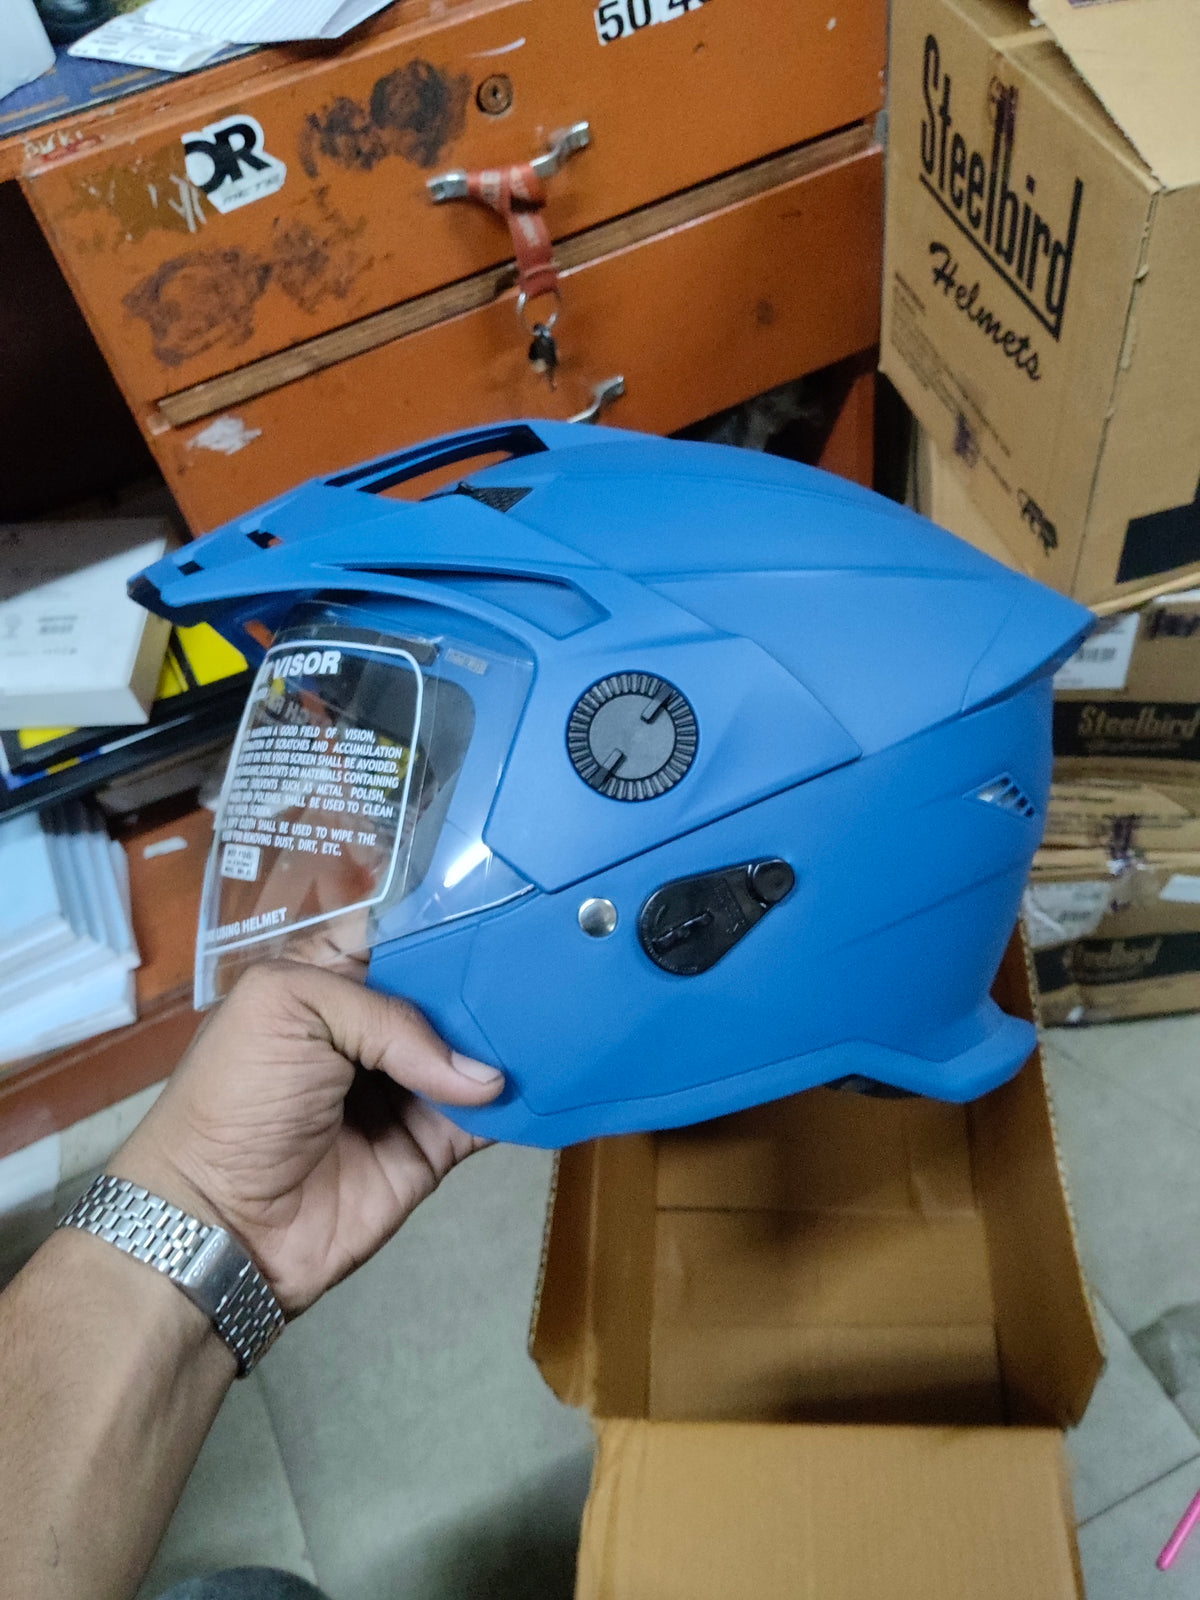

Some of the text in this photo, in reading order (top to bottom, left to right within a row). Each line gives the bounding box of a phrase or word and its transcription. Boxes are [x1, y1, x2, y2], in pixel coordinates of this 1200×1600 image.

[921, 33, 1083, 318] Steelbird
[929, 242, 1041, 381] Helmets
[273, 650, 342, 679] VISOR
[280, 725, 299, 737] GOOD
[300, 725, 320, 738] FIELD
[325, 727, 338, 739] OF
[345, 728, 376, 743] VISION,
[1077, 703, 1200, 740] Steelbird
[273, 752, 290, 764] VISOR
[290, 752, 317, 766] SCREEN
[317, 754, 342, 768] SHALL
[344, 757, 356, 769] BE
[275, 739, 311, 752] SCRATCHES
[311, 740, 329, 753] AND
[332, 741, 403, 759] ACCUMULATION
[260, 765, 289, 778] SOLVENTS
[289, 766, 300, 778] OR
[300, 767, 343, 783] MATERIALS
[344, 771, 400, 789] CONTAINING
[281, 779, 301, 792] SUCH
[302, 782, 313, 794] AS
[316, 783, 344, 797] METAL
[351, 786, 386, 804] POLISH,
[283, 794, 306, 808] SHALL
[309, 796, 321, 809] BE
[322, 798, 346, 812] USED
[347, 800, 360, 814] TO
[362, 803, 394, 818] CLEAN
[257, 818, 277, 833] SHALL
[279, 821, 290, 834] BE
[291, 823, 313, 837] USED
[316, 826, 328, 839] TO
[331, 828, 354, 843] WIPE
[358, 831, 377, 846] THE
[274, 835, 296, 851] DUST,
[297, 838, 318, 854] DIRT,
[322, 841, 342, 856] ETC.
[242, 907, 288, 934] HELMET
